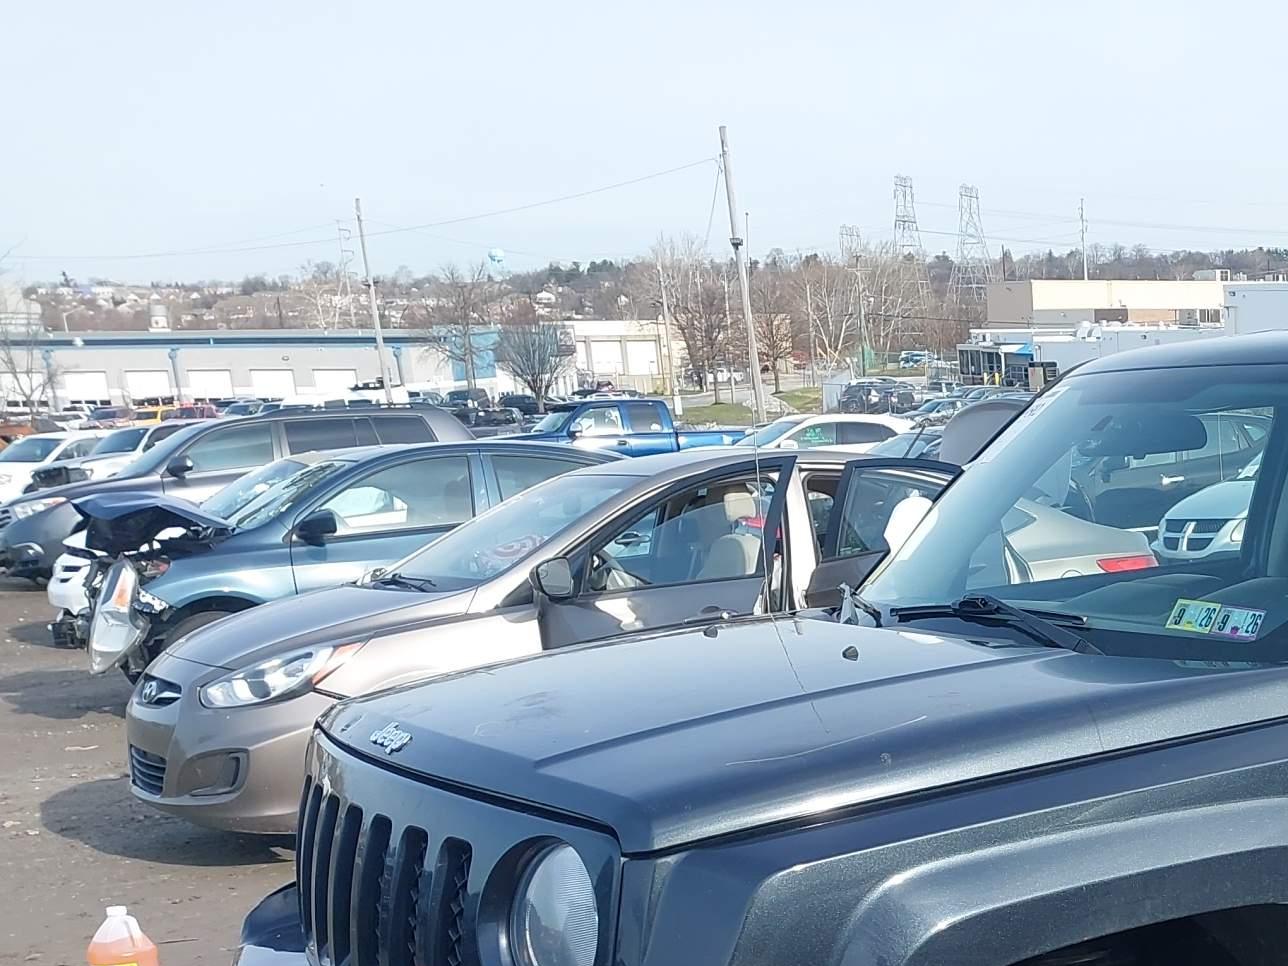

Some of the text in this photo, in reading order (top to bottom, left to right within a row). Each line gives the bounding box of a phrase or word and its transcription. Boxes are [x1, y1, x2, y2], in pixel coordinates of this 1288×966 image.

[1199, 607, 1217, 628] 26
[1244, 613, 1262, 634] 26
[370, 721, 411, 754] Jeep
